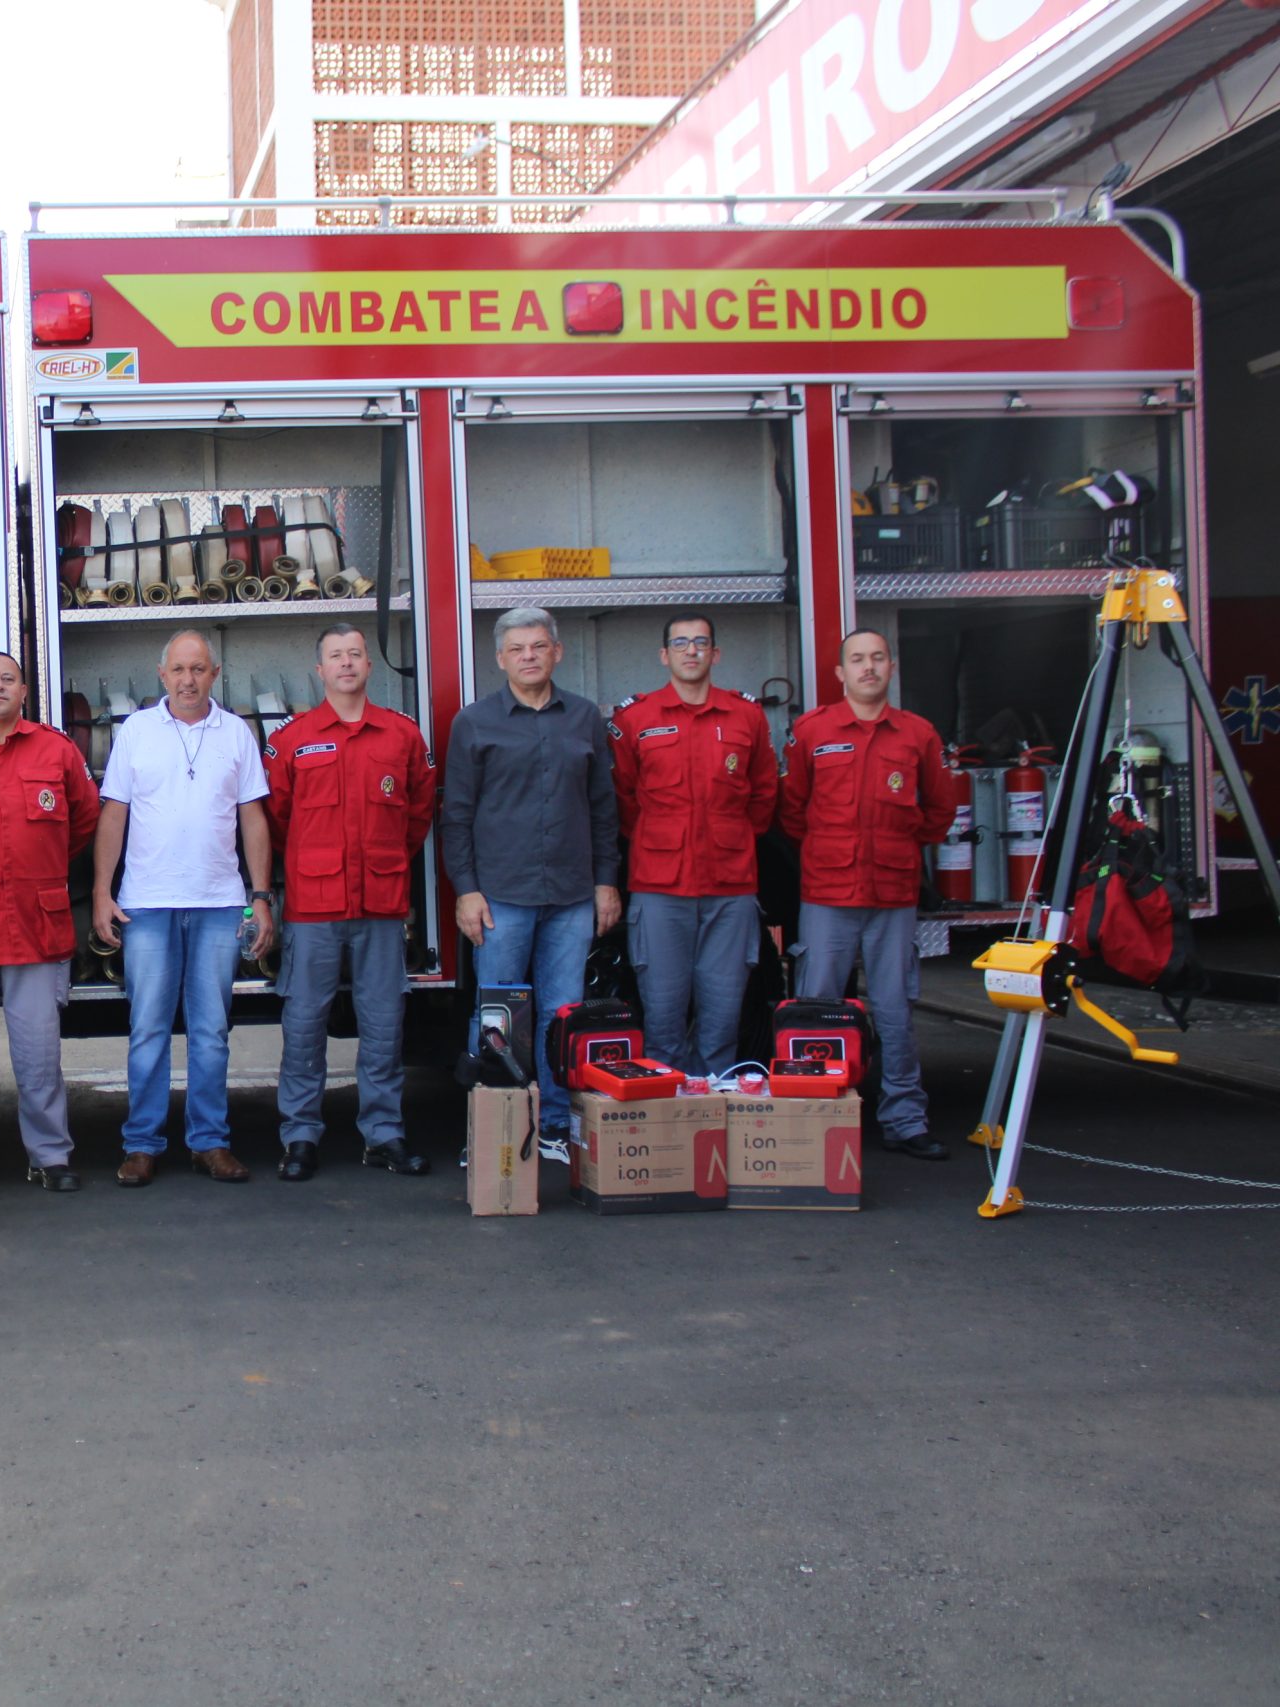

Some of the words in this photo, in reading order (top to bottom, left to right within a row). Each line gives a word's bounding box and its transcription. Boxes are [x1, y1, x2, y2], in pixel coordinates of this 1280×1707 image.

[639, 278, 928, 331] INCÊNDIO
[40, 360, 101, 376] TRIEL-HT
[617, 1141, 650, 1157] i.on
[743, 1132, 777, 1149] i.on
[617, 1163, 650, 1180] i.on
[743, 1155, 777, 1172] i.on
